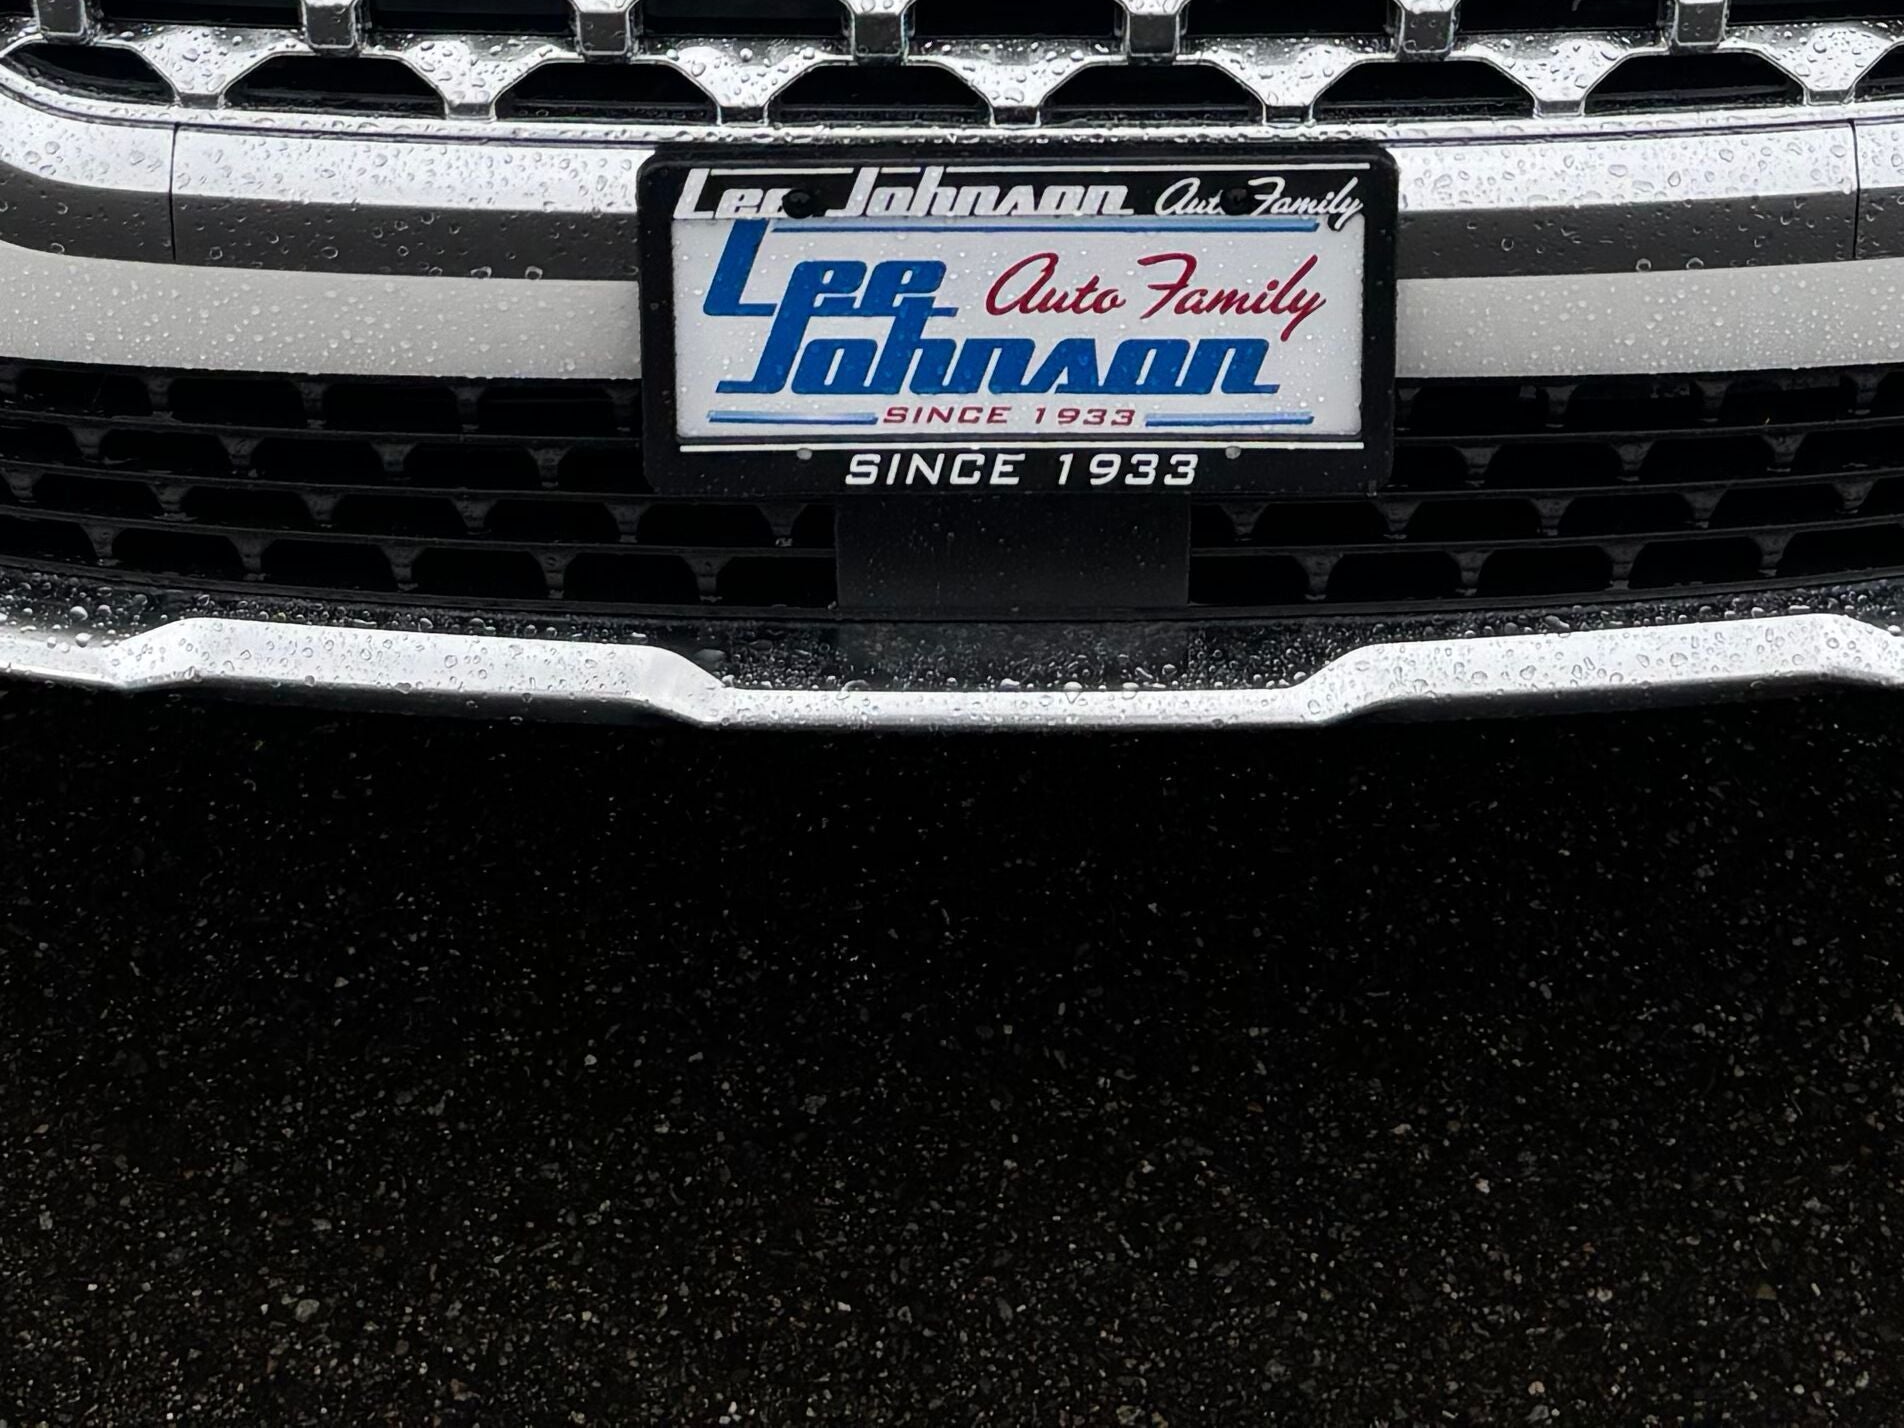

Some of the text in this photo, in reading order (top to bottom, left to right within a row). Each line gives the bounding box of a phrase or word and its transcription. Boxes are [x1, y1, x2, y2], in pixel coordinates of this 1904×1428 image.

[824, 166, 1135, 218] Johnson
[1154, 177, 1226, 216] Aut
[1247, 175, 1364, 232] Family
[702, 219, 958, 318] Lee
[984, 252, 1327, 343] Auto Family
[715, 310, 1280, 395] Johnson
[883, 406, 1136, 426] SINCE 1933
[845, 453, 1199, 486] SINCE 1933
